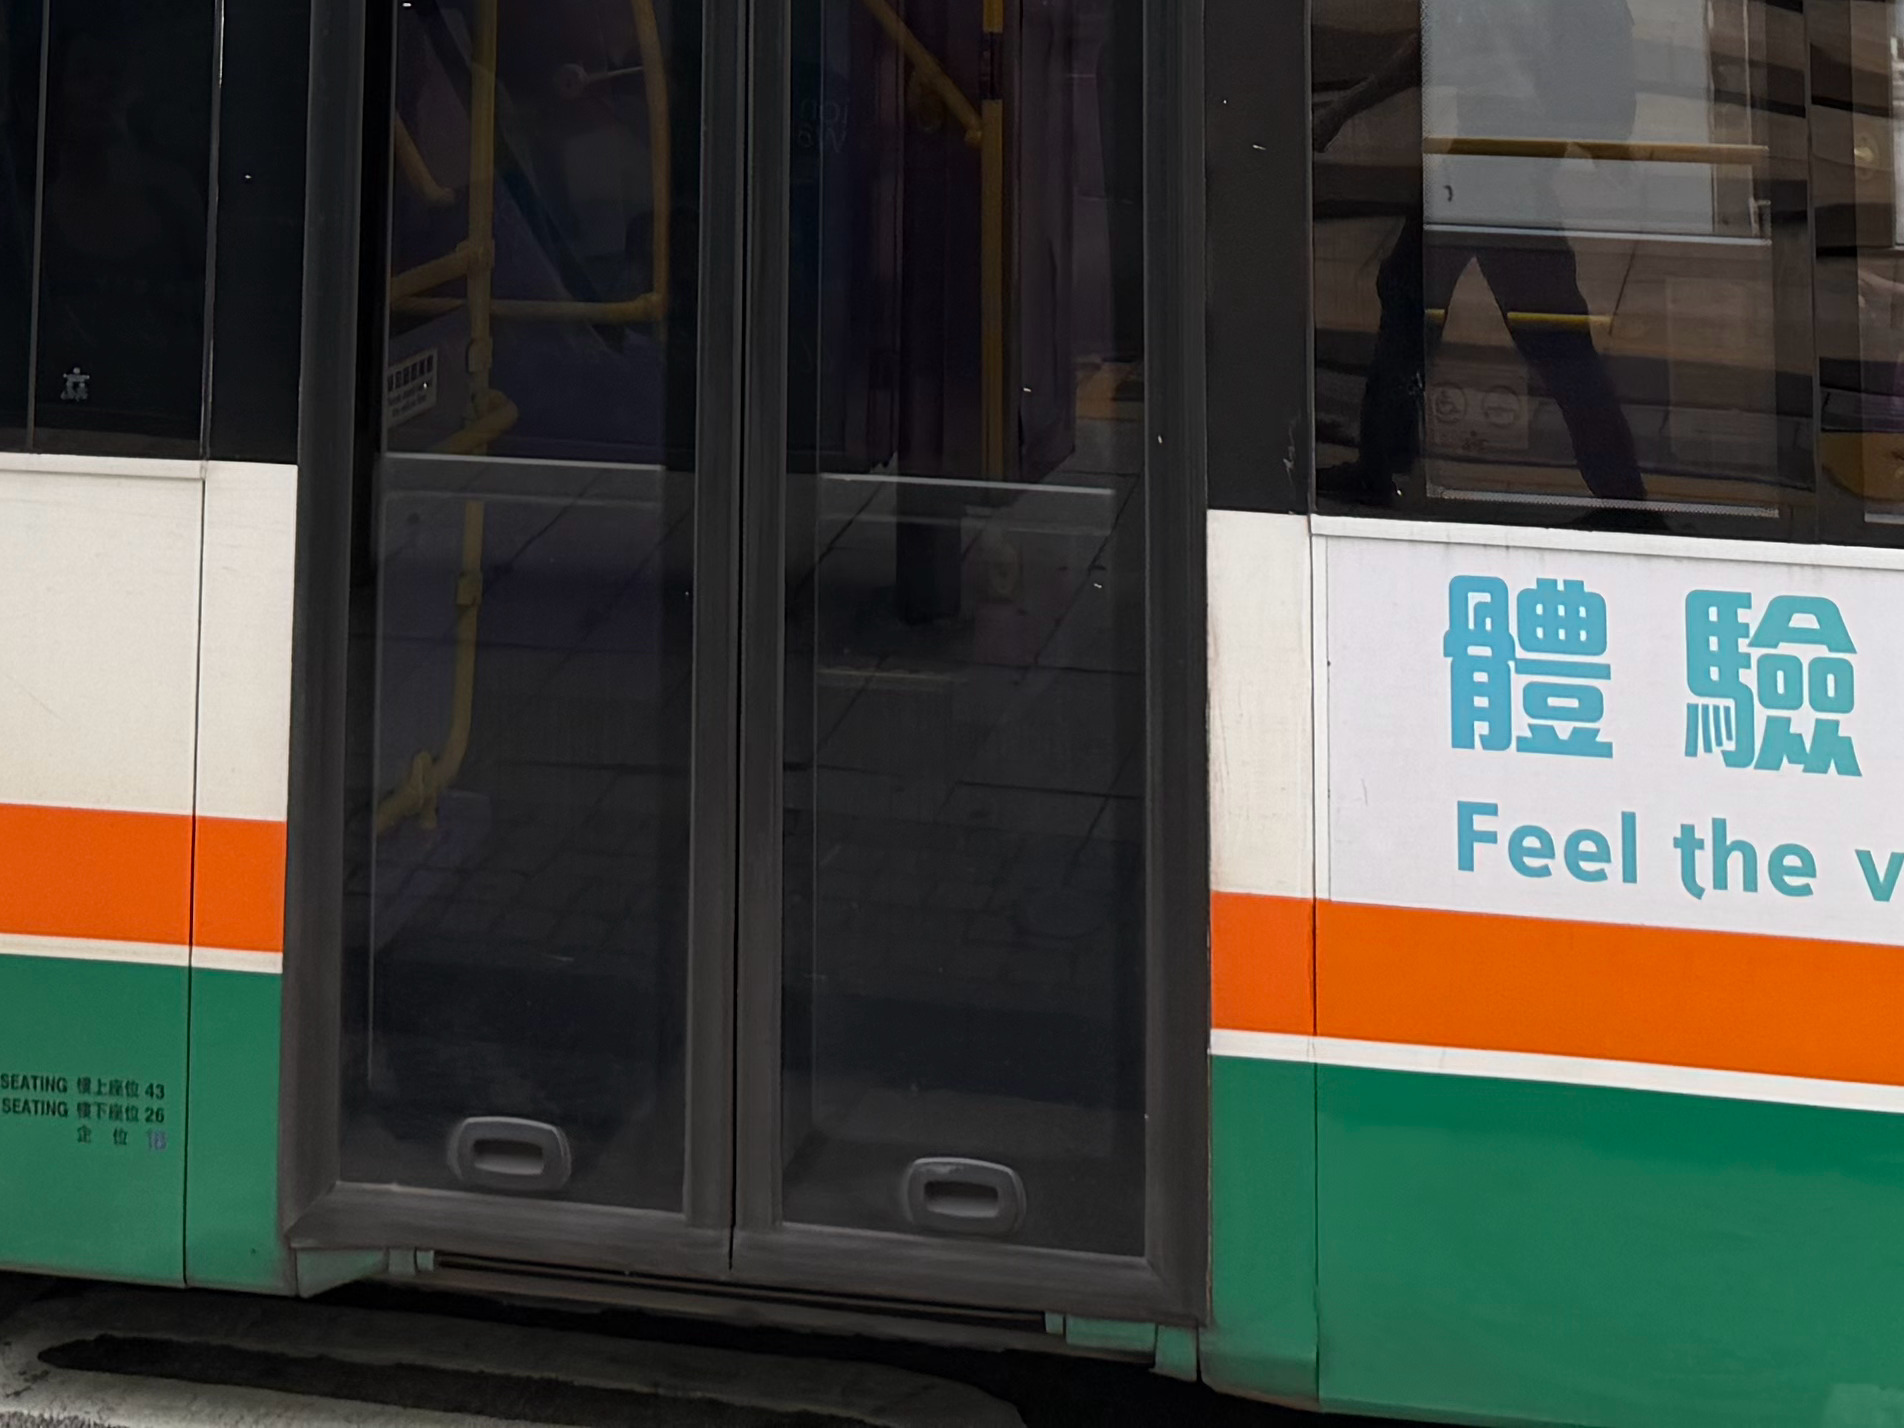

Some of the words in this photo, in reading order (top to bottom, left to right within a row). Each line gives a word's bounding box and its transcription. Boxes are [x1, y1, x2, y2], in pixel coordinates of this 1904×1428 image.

[1455, 801, 1638, 886] Feel
[1673, 815, 1819, 905] the
[0, 1073, 68, 1093] SEATING
[2, 1097, 69, 1118] SEATING
